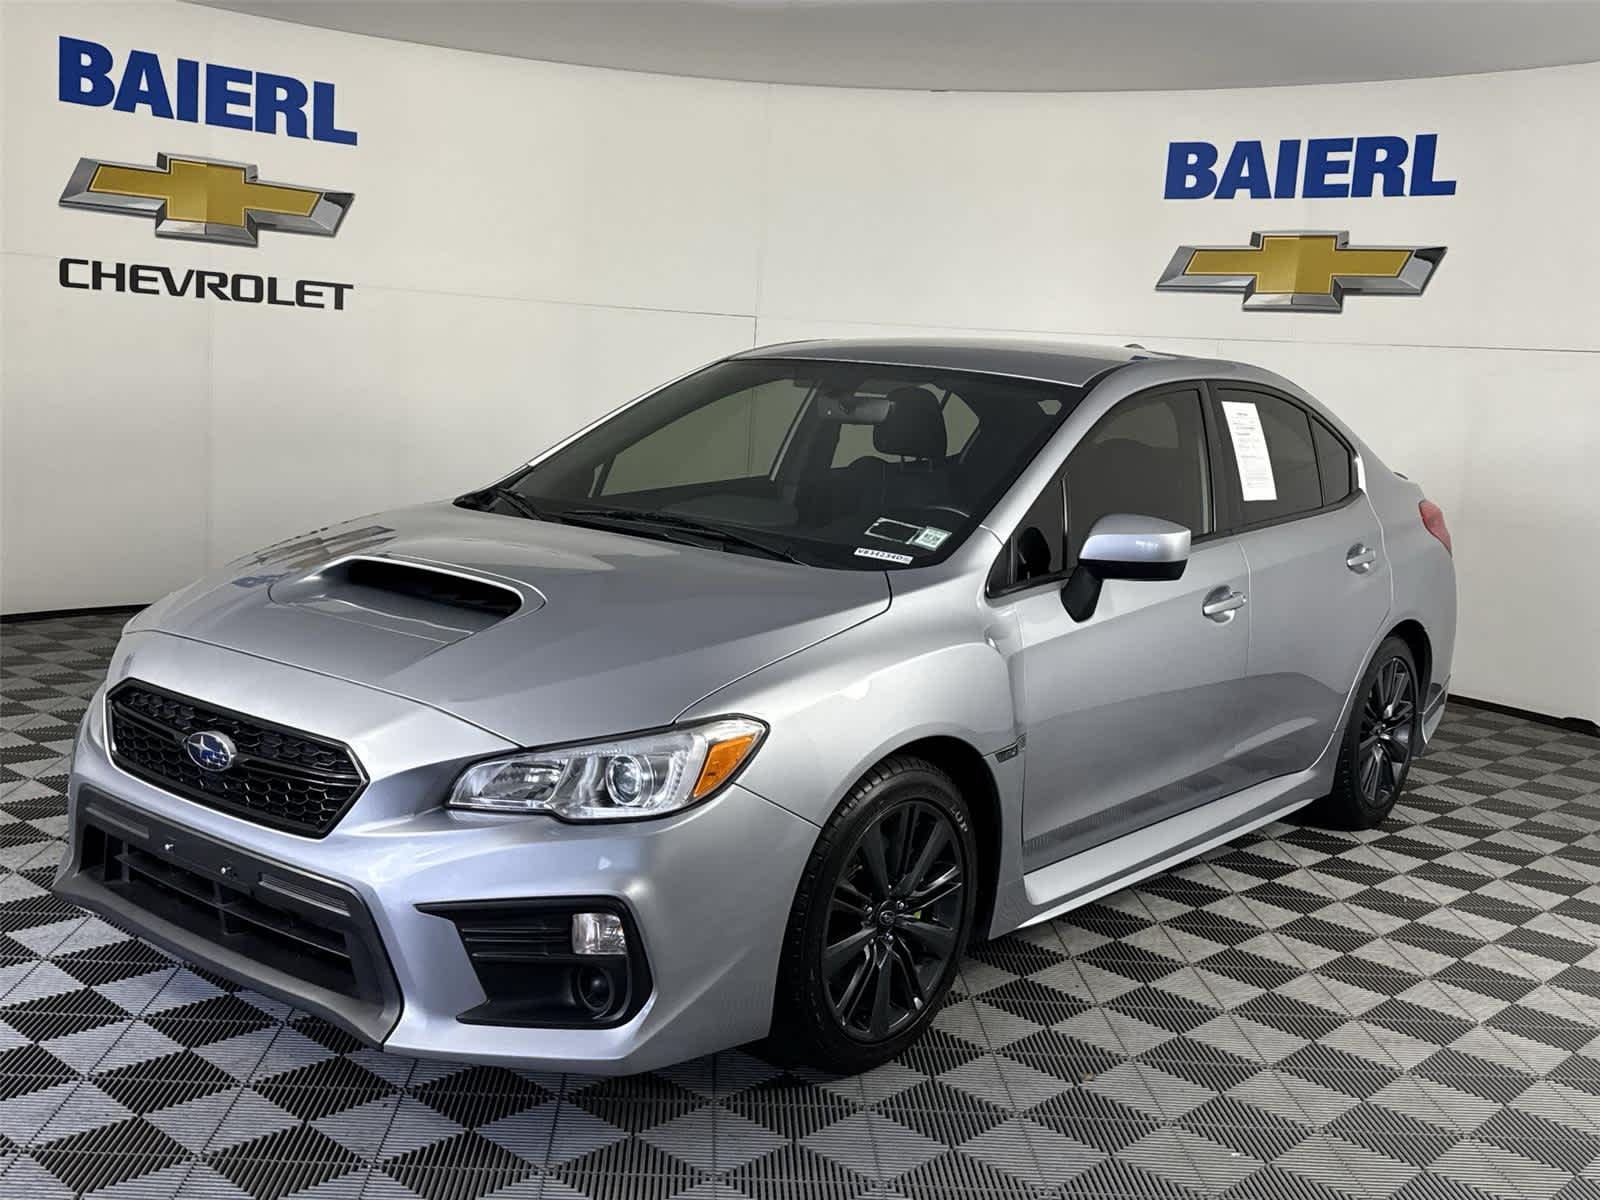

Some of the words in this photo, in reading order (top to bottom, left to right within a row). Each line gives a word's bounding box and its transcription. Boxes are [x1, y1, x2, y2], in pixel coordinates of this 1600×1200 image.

[59, 36, 358, 146] BAIERL
[1164, 134, 1457, 200] BAIERL
[59, 257, 354, 310] CHEVROLET
